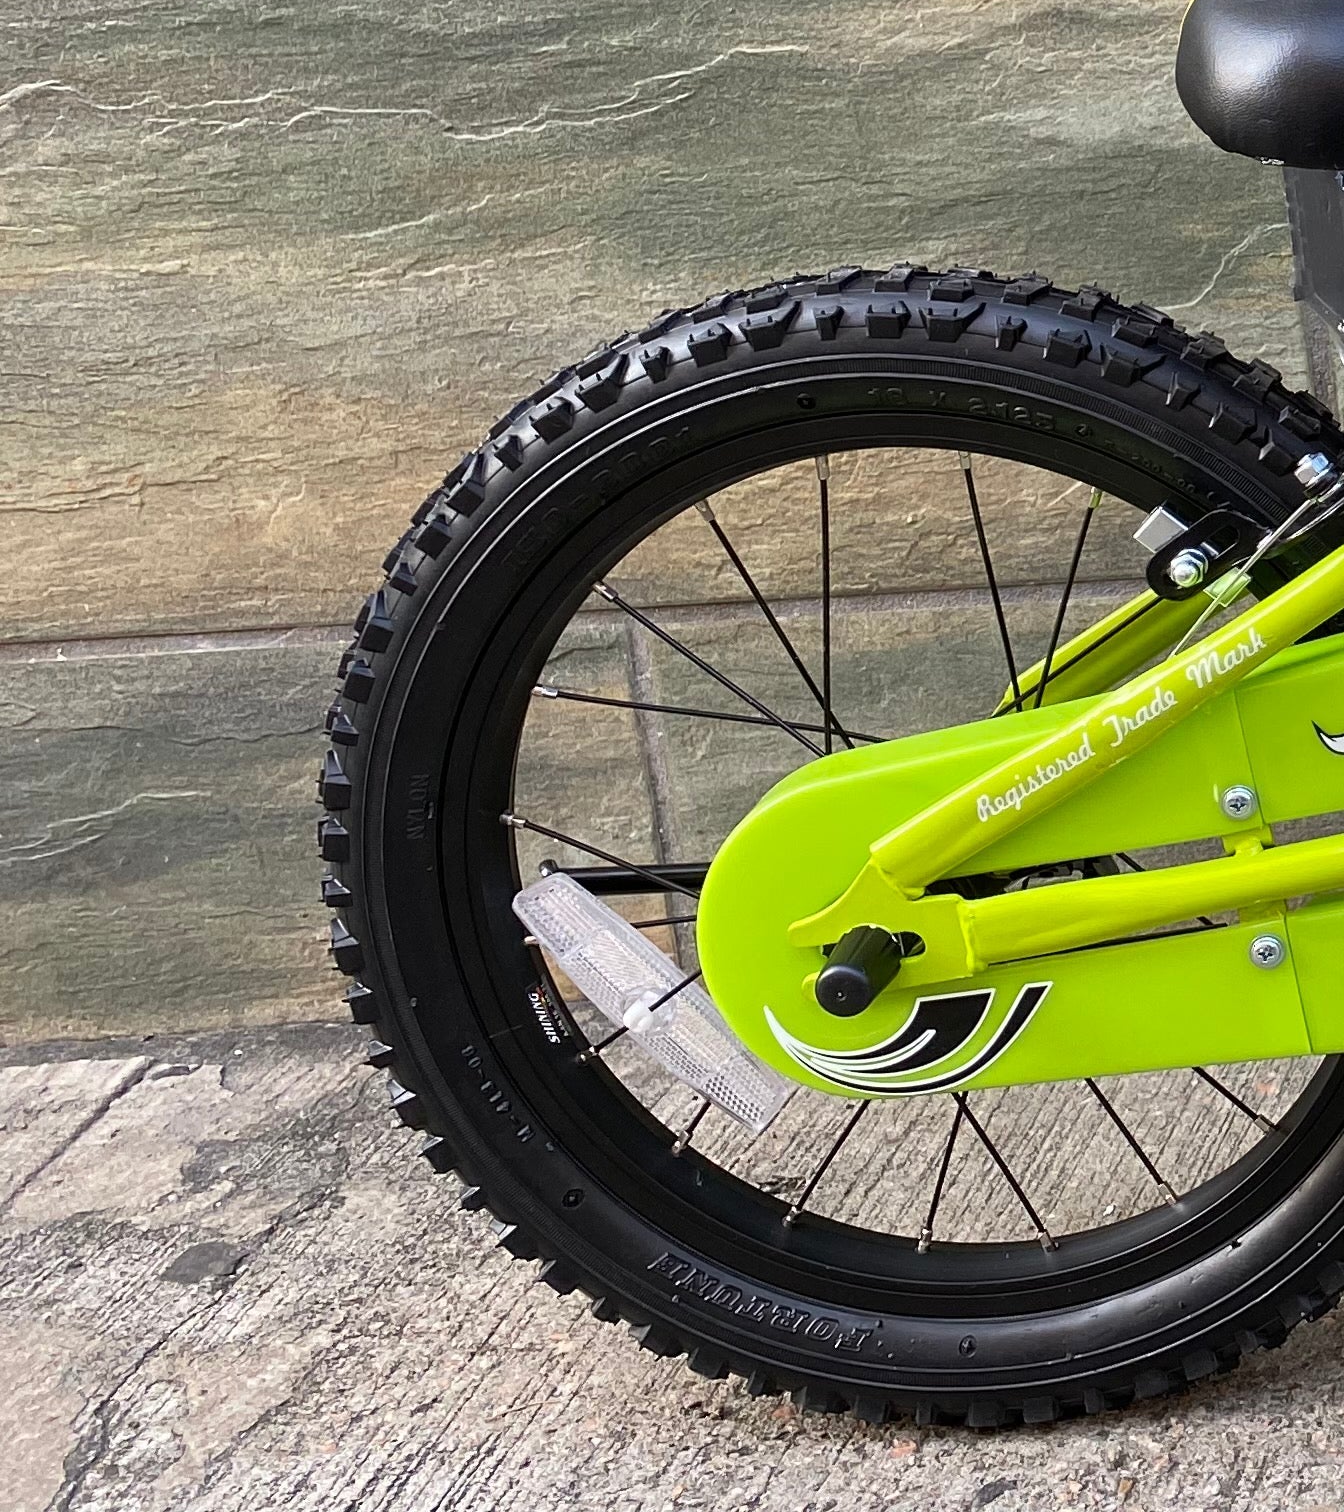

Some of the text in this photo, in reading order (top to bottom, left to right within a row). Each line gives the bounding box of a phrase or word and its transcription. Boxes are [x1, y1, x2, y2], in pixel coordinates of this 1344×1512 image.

[976, 627, 1268, 823] Registered Trade Mark
[527, 992, 561, 1044] SHINING
[646, 1251, 874, 1352] FORTUNE
